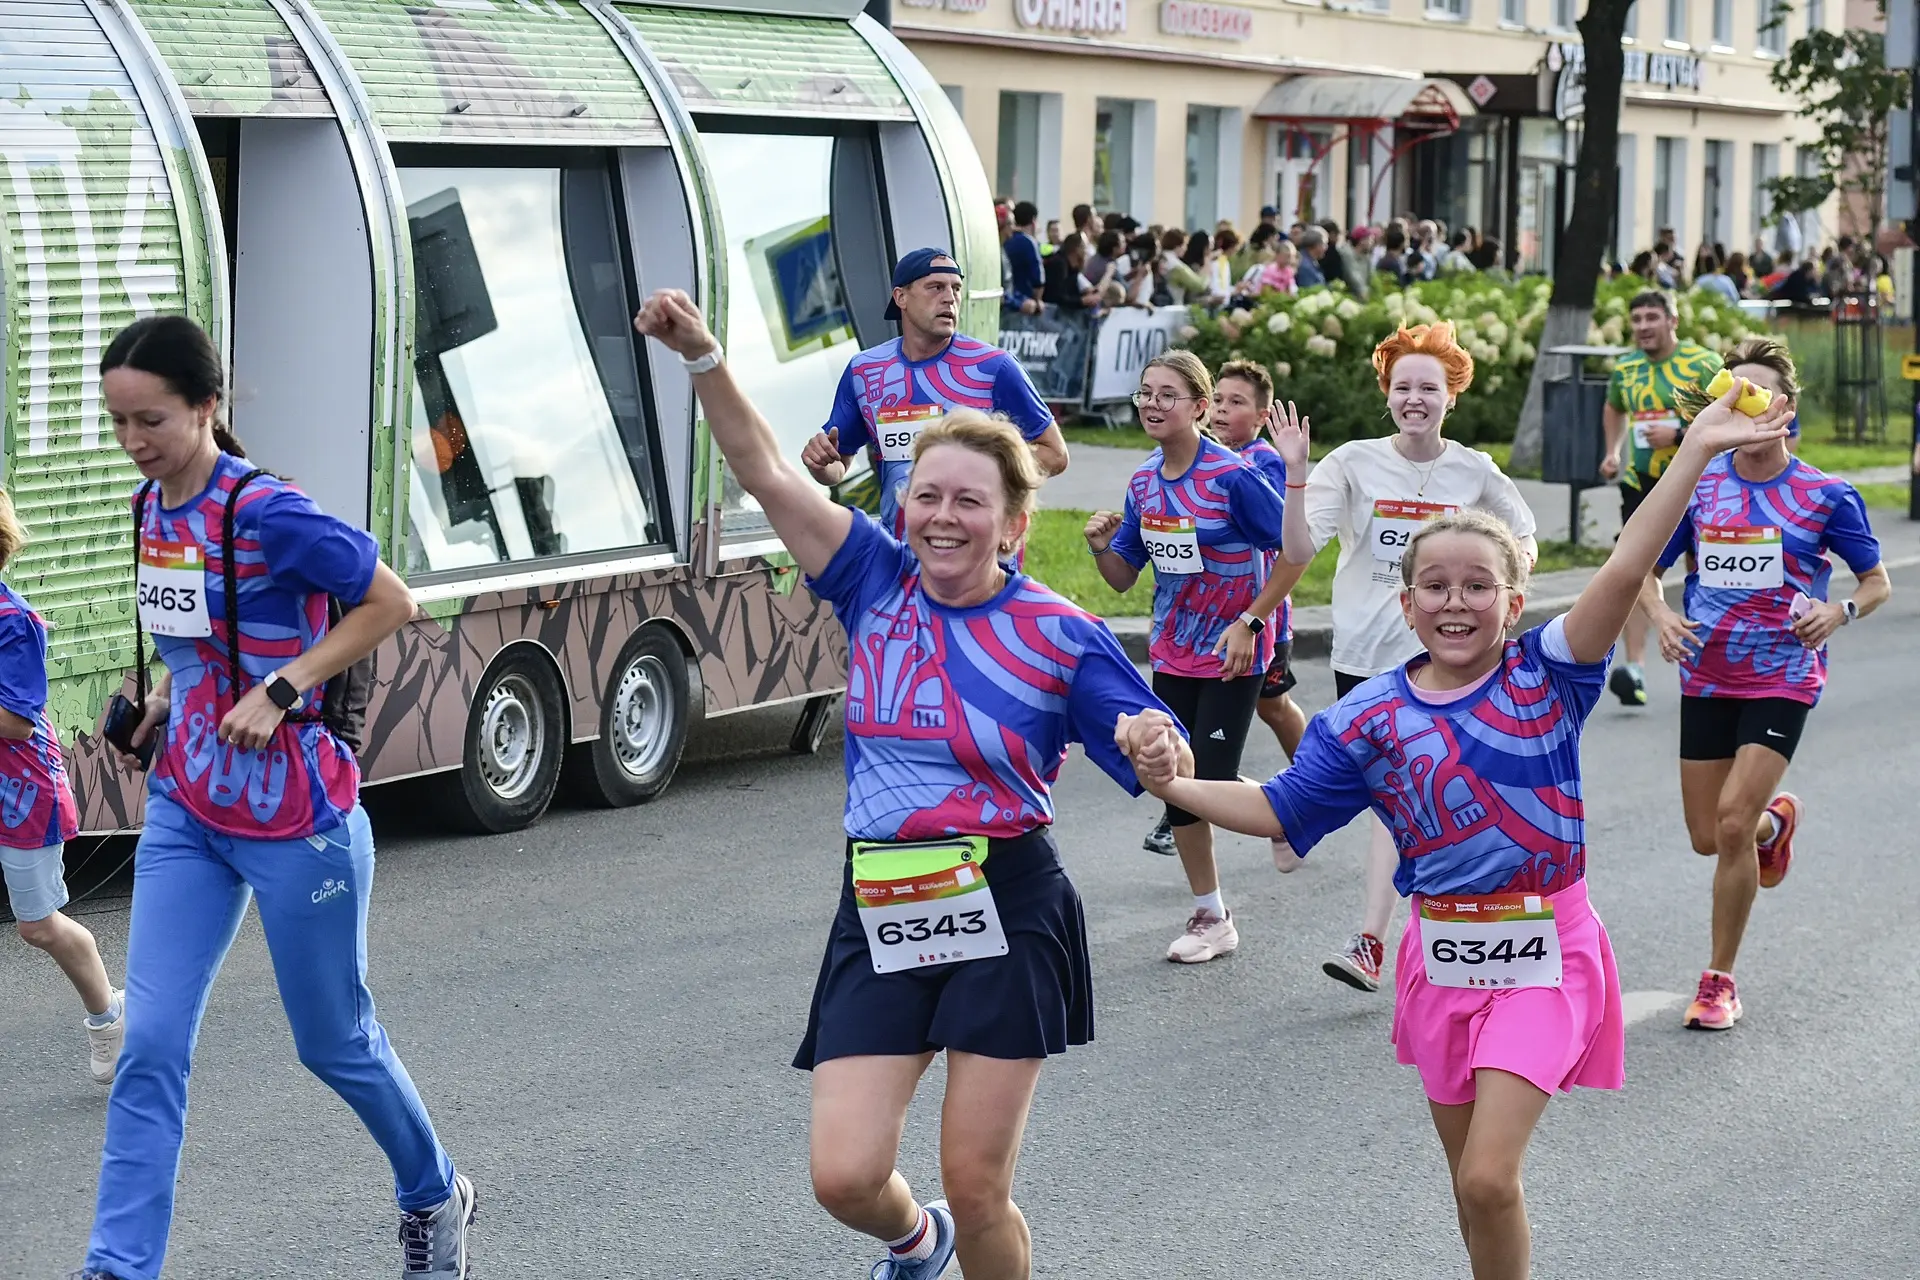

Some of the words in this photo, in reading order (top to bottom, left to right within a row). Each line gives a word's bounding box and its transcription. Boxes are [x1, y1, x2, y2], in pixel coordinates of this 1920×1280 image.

[1166, 3, 1252, 36] ПУХОВИКИ
[884, 431, 922, 448] 59
[1145, 540, 1193, 559] 6203
[1380, 529, 1410, 547] 61
[1704, 555, 1775, 573] 6407
[138, 582, 197, 613] 5463
[876, 909, 988, 946] 6343
[1431, 936, 1548, 965] 6344
